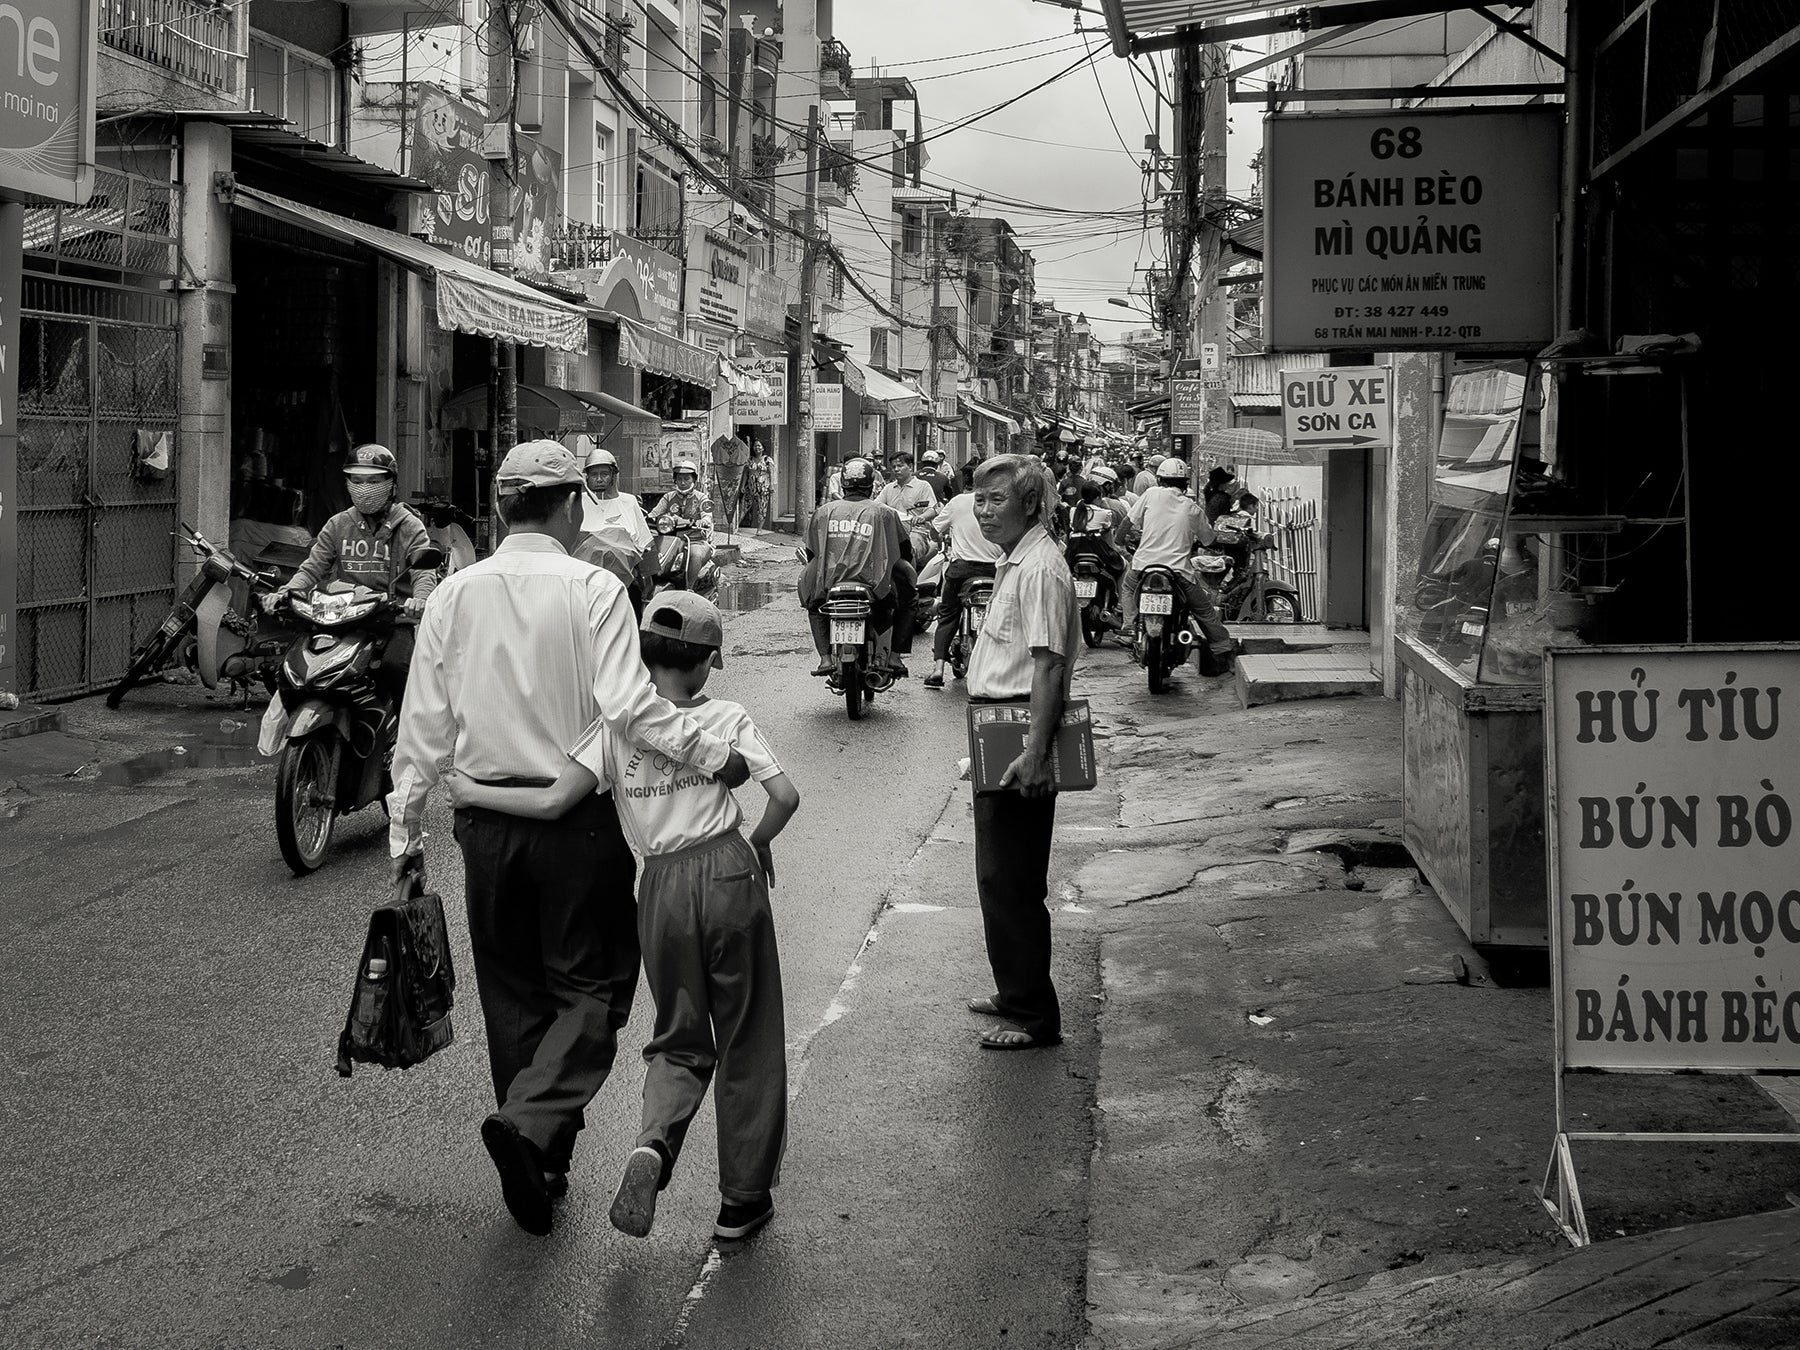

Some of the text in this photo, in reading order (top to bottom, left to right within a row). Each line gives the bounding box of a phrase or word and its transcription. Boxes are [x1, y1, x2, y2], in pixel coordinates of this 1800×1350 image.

[4, 91, 59, 124] mọi nơi
[1370, 126, 1423, 160] 68
[1314, 169, 1483, 208] BÁNH BÈO
[1315, 215, 1482, 260] MÌ QUẢNG
[1312, 277, 1339, 295] PHỤC
[1341, 277, 1354, 295] VỤ
[1358, 275, 1378, 292] CÁC
[1381, 274, 1404, 291] MÓN
[1453, 275, 1485, 291] TRUNG
[1335, 305, 1449, 318] ĐT: 38 427 449
[1314, 327, 1328, 339] 68
[1366, 326, 1387, 338] MAI
[1175, 383, 1199, 394] Café
[1286, 373, 1386, 408] GIỮ XE
[1297, 411, 1377, 432] SƠN CA
[828, 519, 873, 537] ROBO
[1575, 667, 1781, 744] HỦ TÍU
[1578, 778, 1792, 849] BÚN BÒ
[1571, 878, 1800, 959] BÚN MỌC
[1575, 974, 1708, 1044] BÁNH
